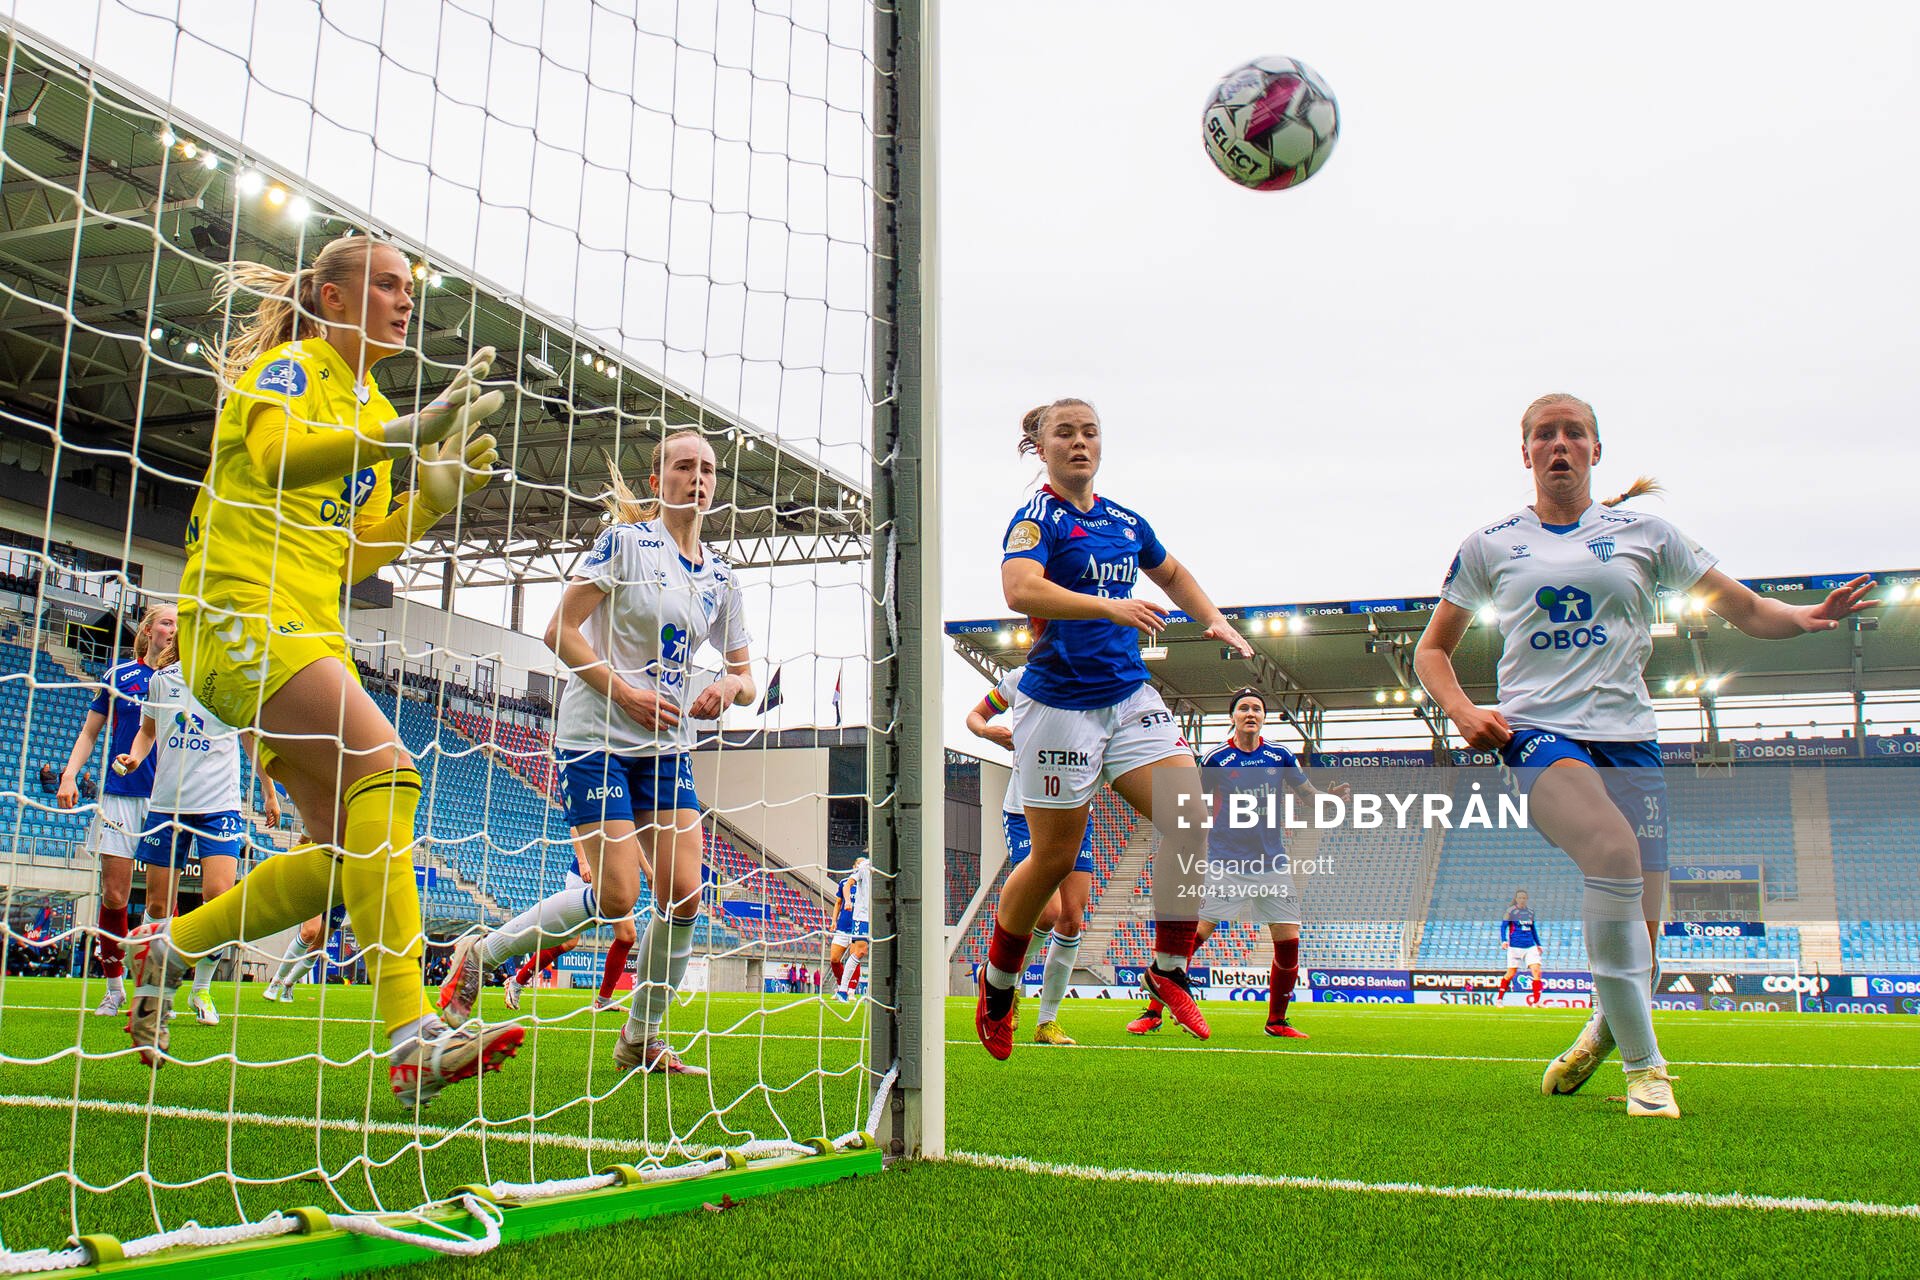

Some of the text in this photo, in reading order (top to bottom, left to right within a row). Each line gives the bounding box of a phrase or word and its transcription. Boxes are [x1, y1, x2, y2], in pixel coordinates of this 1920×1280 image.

[1207, 116, 1262, 176] SELECT
[1484, 517, 1520, 535] coop
[1776, 583, 1804, 592] OBOS
[1267, 610, 1291, 618] OBOS
[1320, 608, 1344, 616] OBOS
[1373, 605, 1398, 613] OBOS
[1165, 616, 1188, 624] OBOS
[1530, 624, 1608, 650] OBOS
[120, 669, 141, 681] coop
[1263, 750, 1282, 761] coop
[1752, 743, 1847, 758] OBOS Banken
[1219, 752, 1236, 766] coop
[1342, 755, 1425, 767] OBOS Banken
[1043, 775, 1061, 797] 10
[586, 786, 624, 800] AEKO
[221, 816, 237, 831] 22
[1707, 869, 1741, 880] OBOS
[1704, 926, 1741, 937] OBOS
[562, 952, 592, 971] intility
[1331, 975, 1406, 987] OBOS Banken
